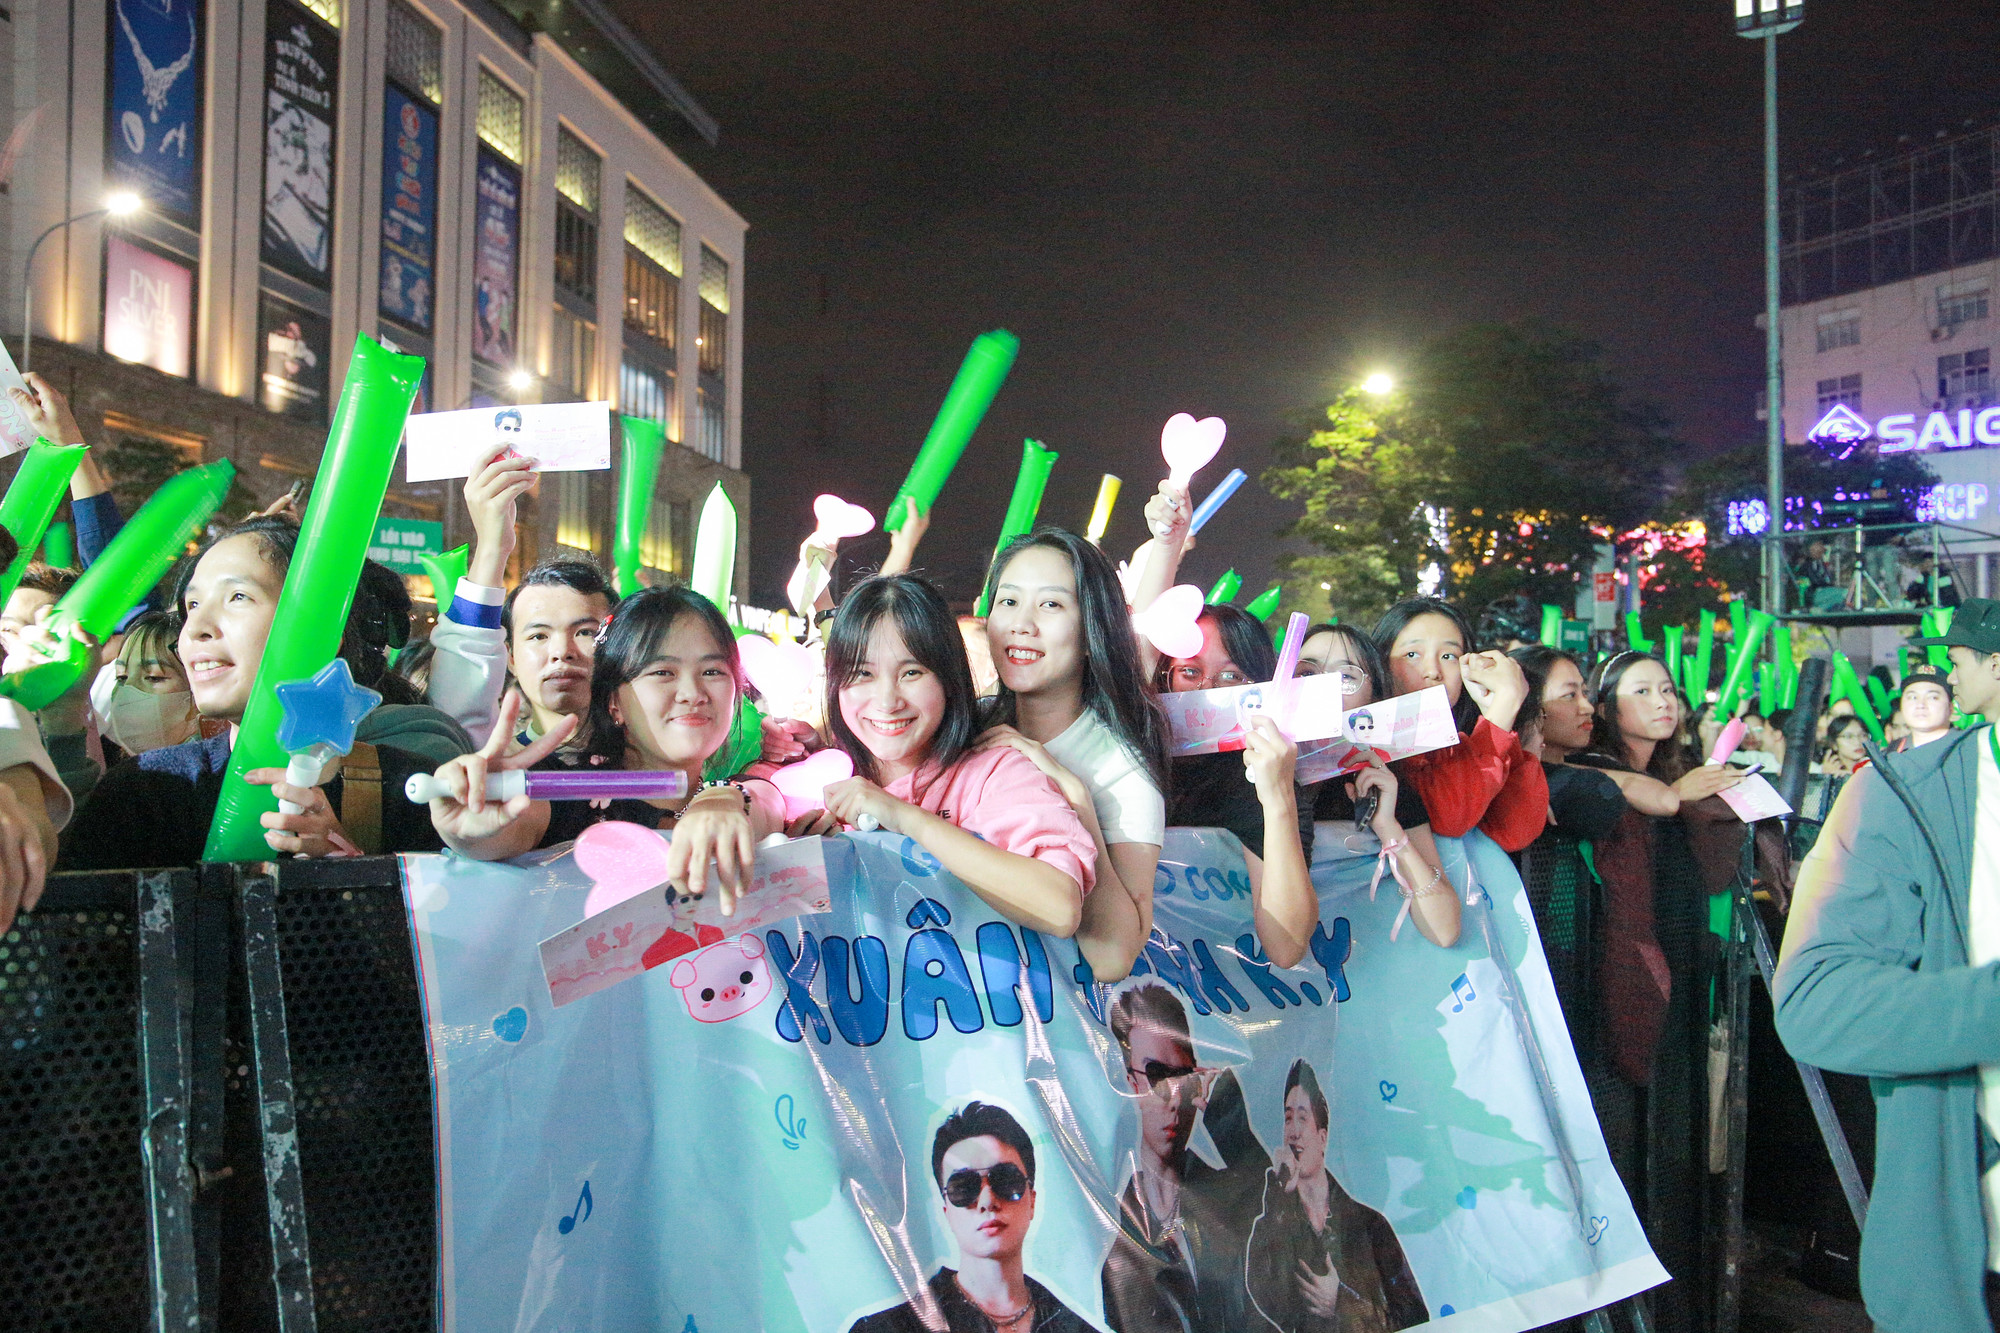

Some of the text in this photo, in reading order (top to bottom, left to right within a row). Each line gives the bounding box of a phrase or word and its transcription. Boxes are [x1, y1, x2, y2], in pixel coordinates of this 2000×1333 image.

[129, 269, 171, 316] PNJ
[120, 297, 178, 340] SILVER
[766, 898, 1054, 1047] XUÂN
